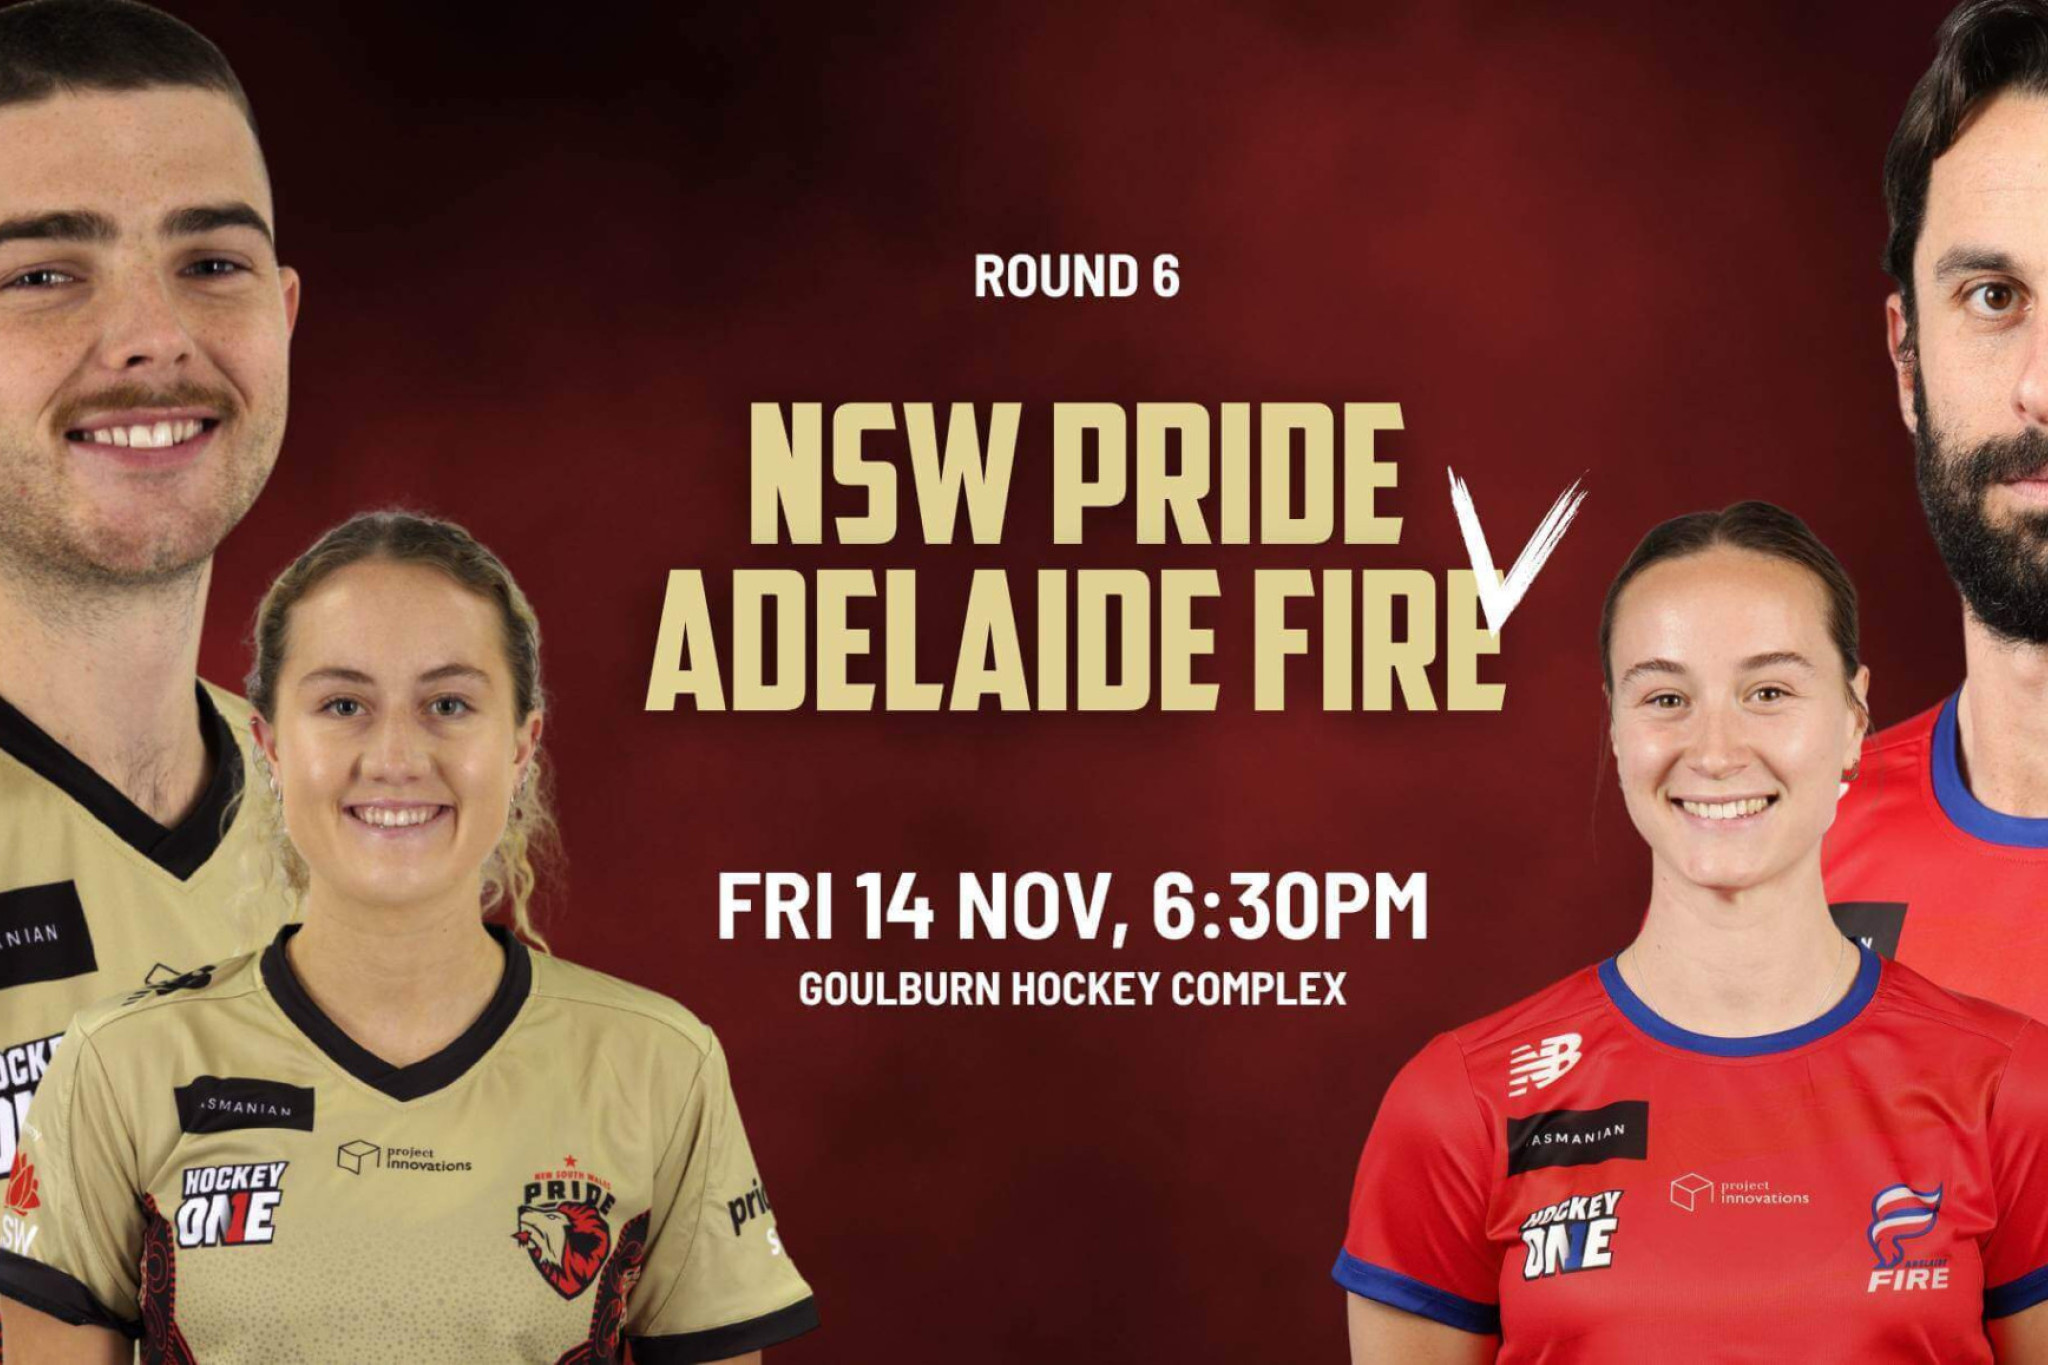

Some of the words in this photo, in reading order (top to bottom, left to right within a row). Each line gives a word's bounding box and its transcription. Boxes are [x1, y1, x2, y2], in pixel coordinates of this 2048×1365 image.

[0, 924, 58, 950] NIAN
[201, 1098, 292, 1117] SMANIAN
[1525, 1123, 1625, 1148] ASMANIAN
[386, 1158, 472, 1173] innovations
[387, 1147, 434, 1160] project
[184, 1162, 288, 1196] HOCKEY
[1721, 1180, 1770, 1193] project
[523, 1180, 617, 1216] PRIDE
[1525, 1190, 1624, 1228] HOCKEY
[1721, 1192, 1810, 1206] innovations
[1867, 1267, 1950, 1293] FIRE
